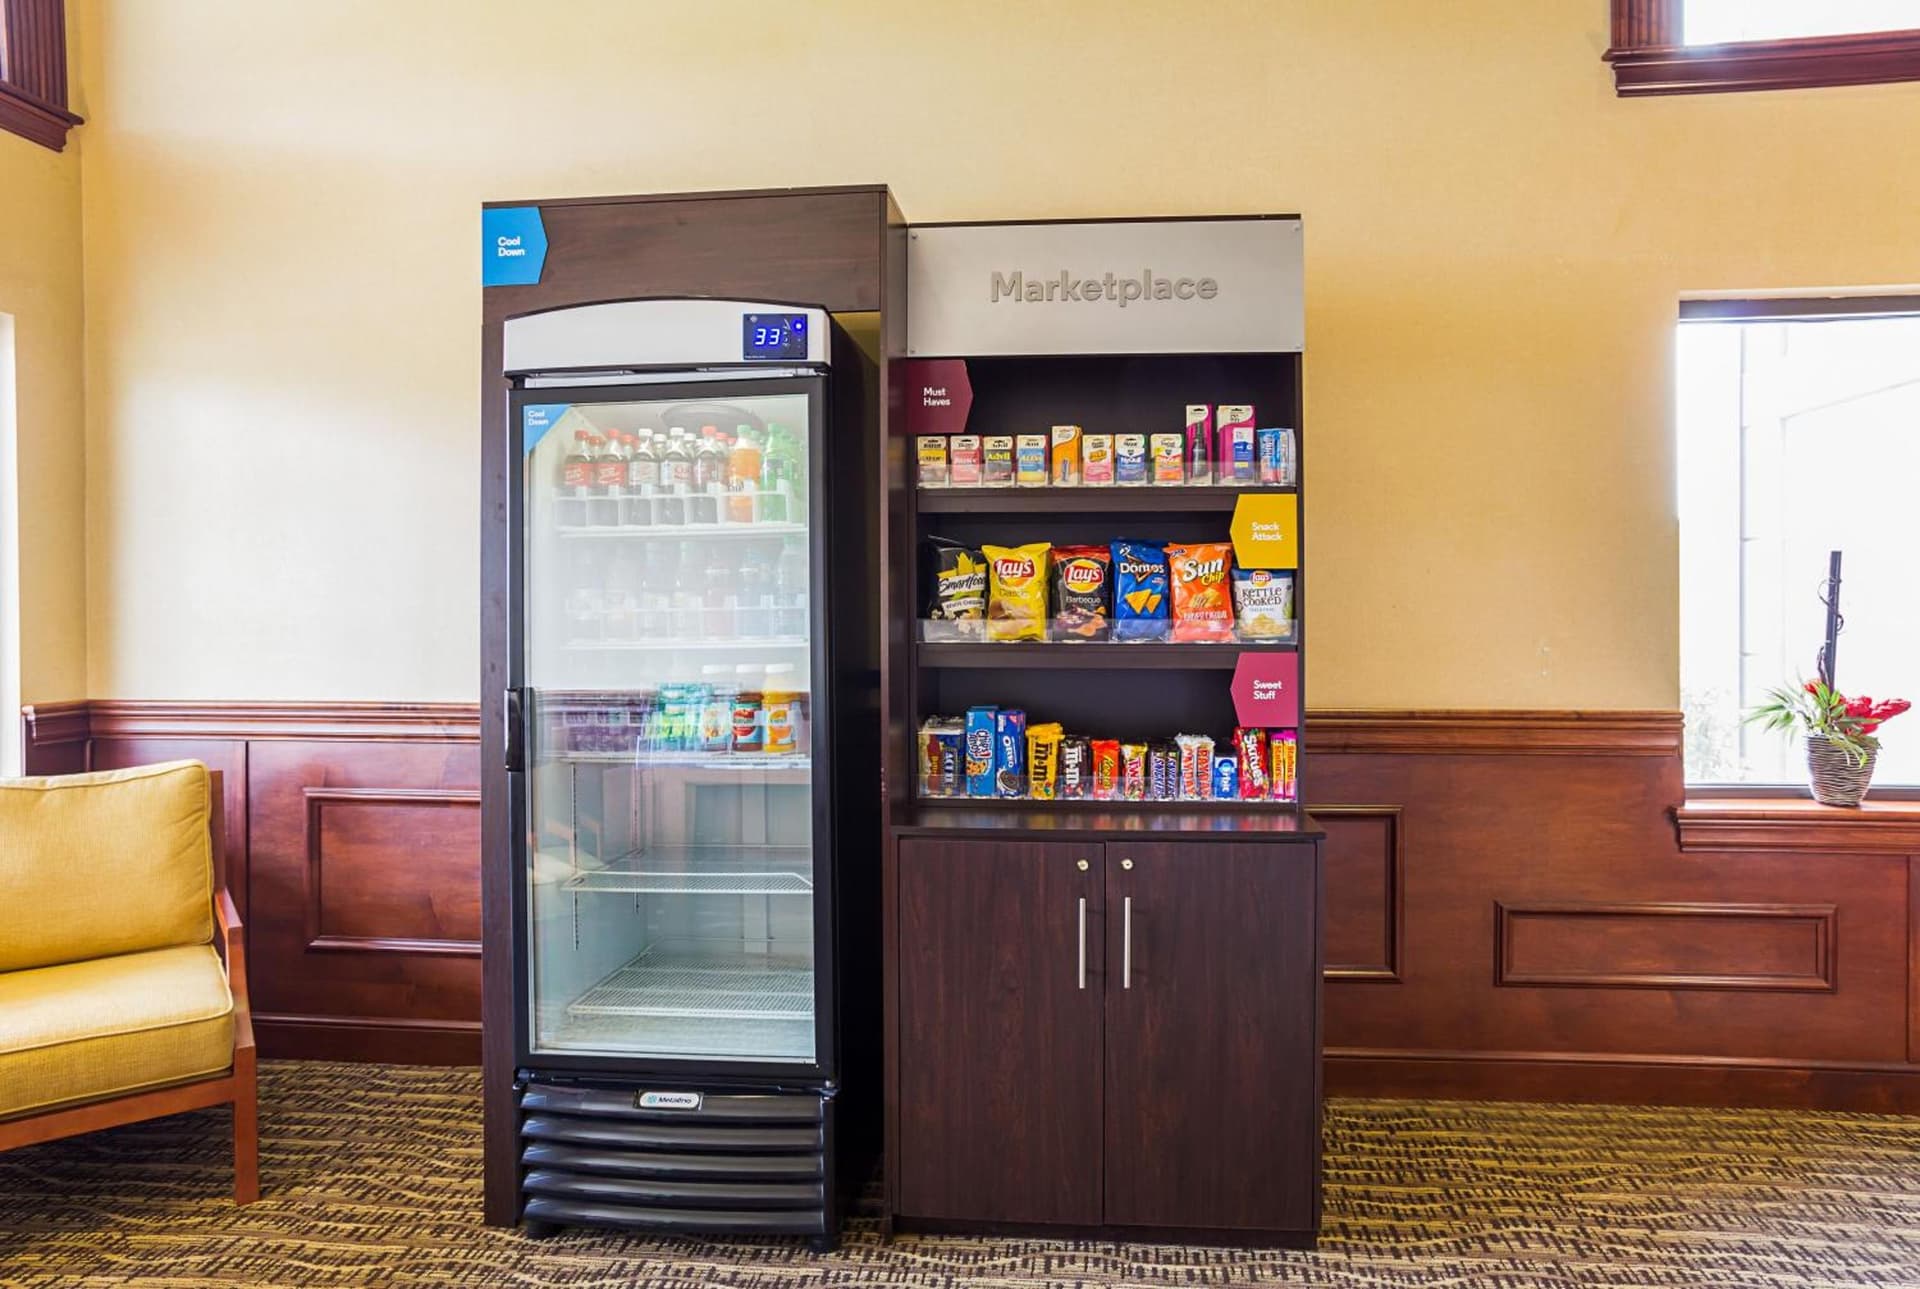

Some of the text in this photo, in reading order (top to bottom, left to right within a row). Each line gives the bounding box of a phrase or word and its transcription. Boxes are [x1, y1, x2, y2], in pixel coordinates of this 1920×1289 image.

[498, 236, 520, 246] Cool
[498, 247, 525, 257] Down
[991, 269, 1218, 308] Marketplace
[755, 328, 780, 345] 33
[924, 387, 946, 397] Must
[924, 397, 951, 407] Haves
[528, 409, 545, 418] Cool
[528, 418, 549, 427] Down
[987, 451, 1011, 462] Advil
[1251, 521, 1281, 531] Snack
[1251, 531, 1283, 542] Attack
[1119, 562, 1165, 574] Doritos
[1182, 559, 1224, 583] Sun
[1067, 566, 1101, 584] Lay's
[940, 572, 986, 594] Smartfoo
[1065, 595, 1101, 604] Barbecue
[1253, 680, 1283, 690] Sweet
[1253, 690, 1276, 700] Stuff
[1243, 735, 1263, 787] Skittles
